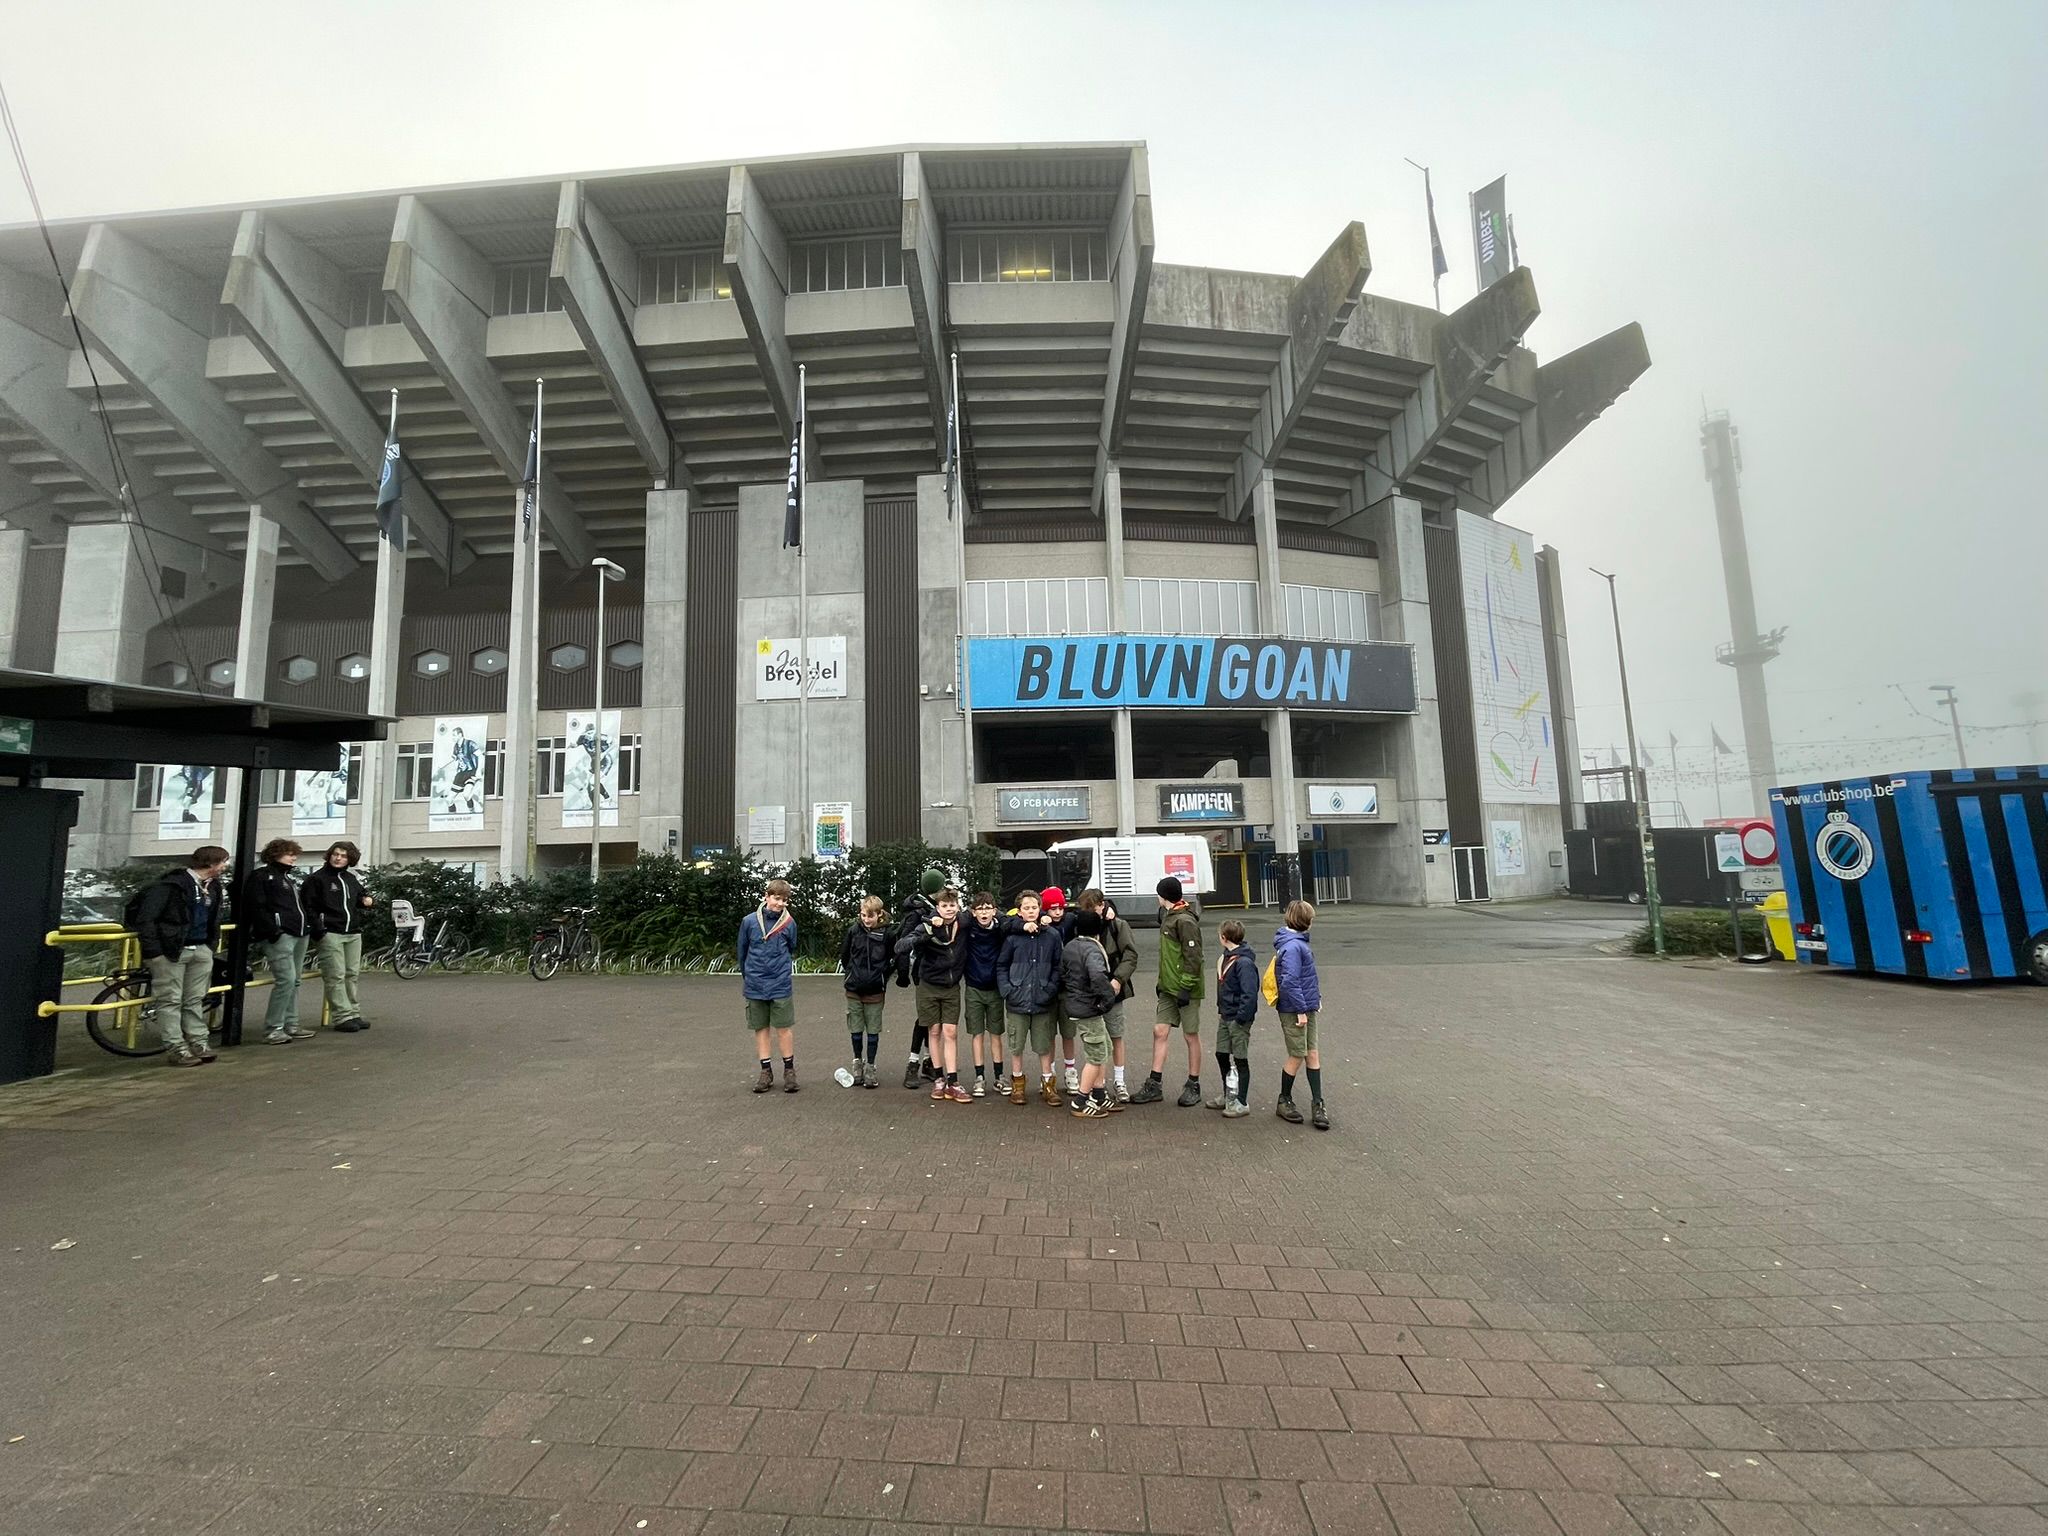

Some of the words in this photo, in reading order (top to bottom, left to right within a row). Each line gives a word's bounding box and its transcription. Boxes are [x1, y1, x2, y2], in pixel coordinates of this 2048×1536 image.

[1479, 210, 1495, 263] UNIBET
[1016, 643, 1200, 701] BLUVN
[1217, 644, 1352, 702] GOAN
[1023, 798, 1042, 808] FCB
[1043, 797, 1079, 807] KAFFEE
[1783, 783, 1894, 806] www.clubshop.be
